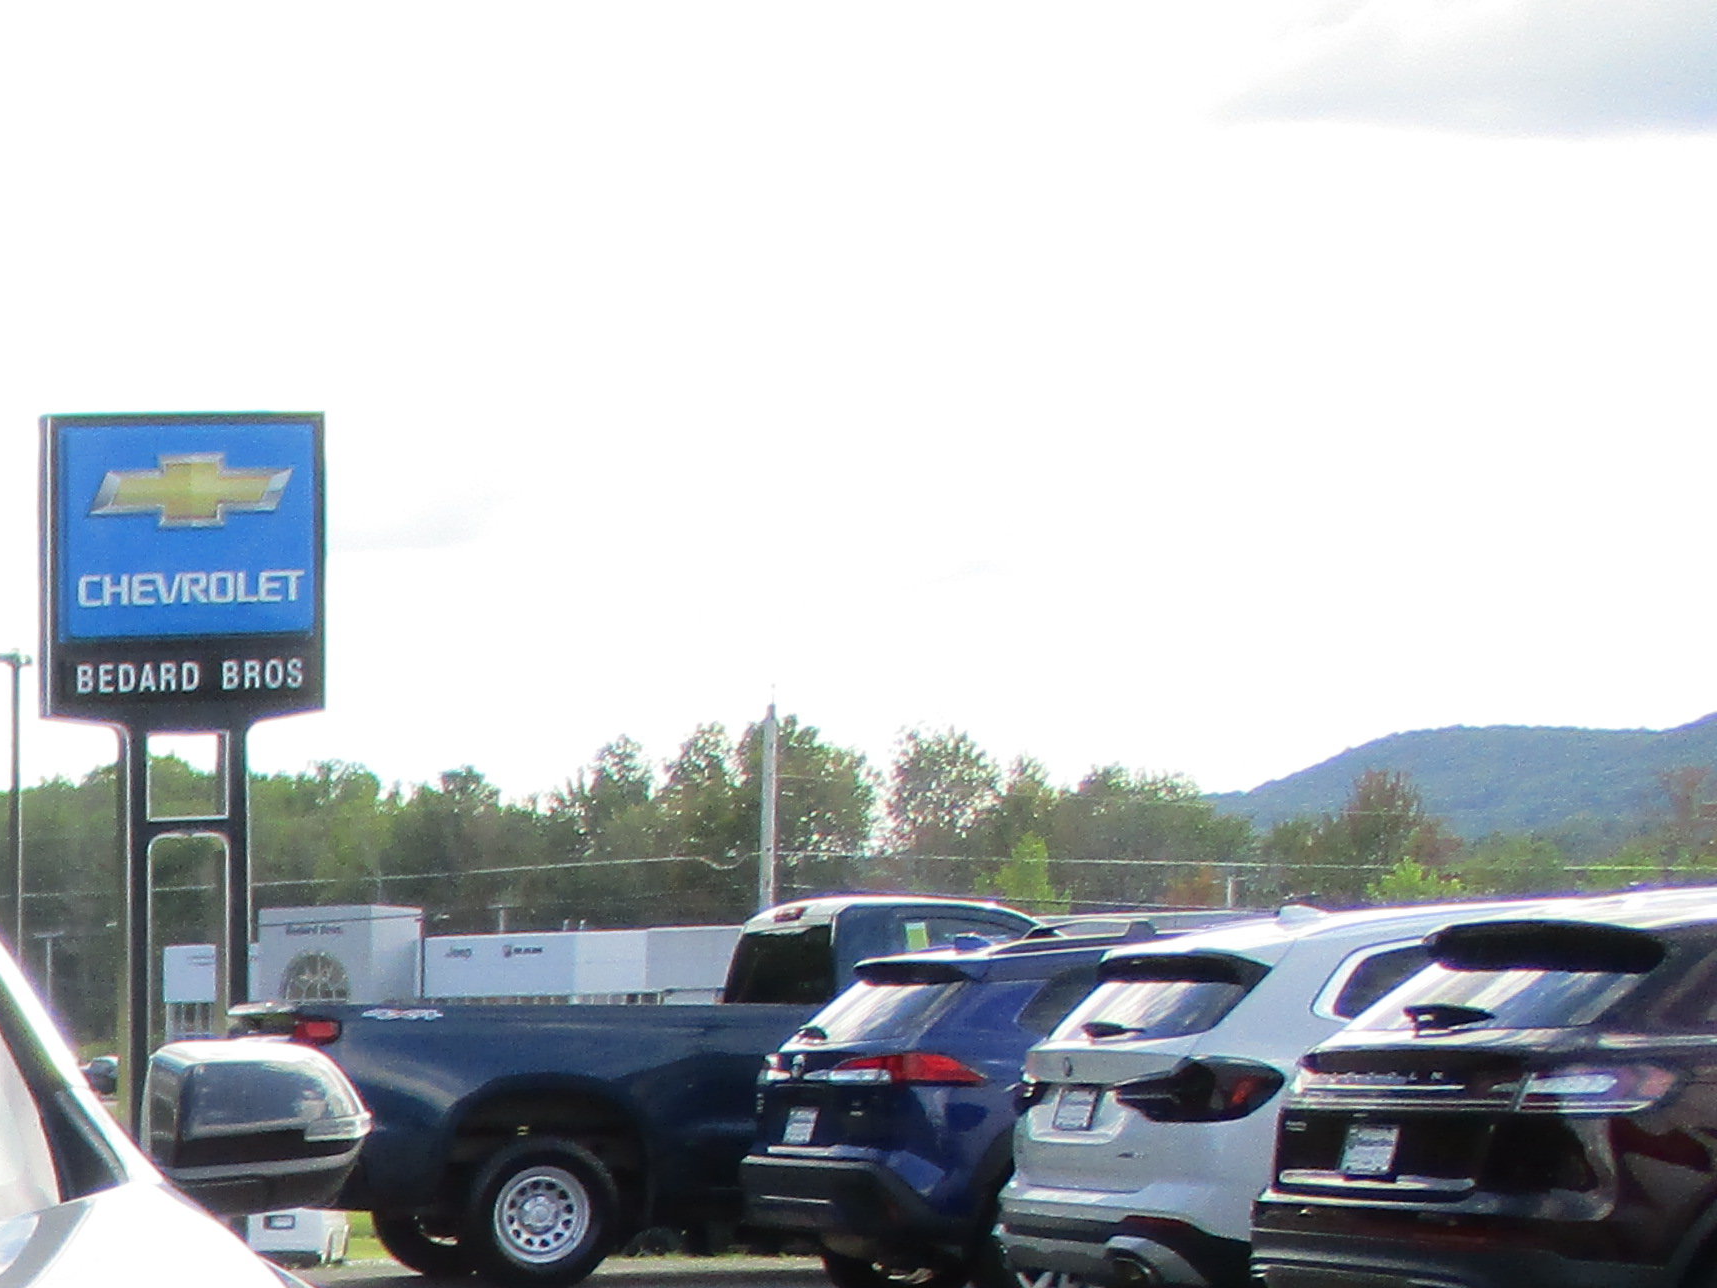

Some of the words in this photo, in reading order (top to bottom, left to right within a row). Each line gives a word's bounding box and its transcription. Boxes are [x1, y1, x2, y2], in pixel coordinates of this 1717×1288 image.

[77, 570, 306, 608] CHEVROLET
[76, 661, 201, 694] BEDARD
[221, 658, 304, 691] BROS
